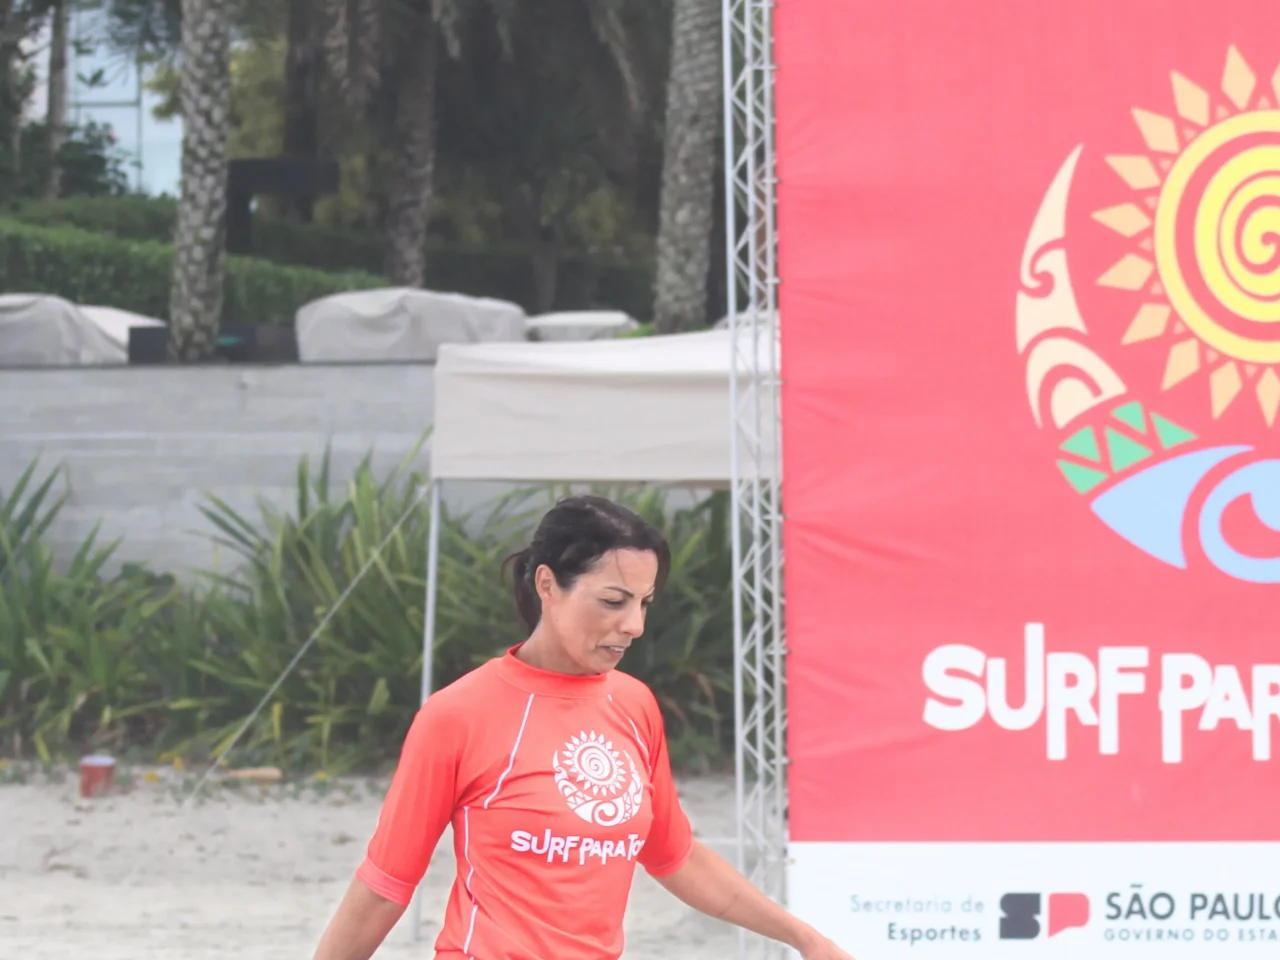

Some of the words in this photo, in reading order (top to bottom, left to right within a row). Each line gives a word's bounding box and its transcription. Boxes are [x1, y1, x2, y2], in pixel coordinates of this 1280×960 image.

[922, 622, 1149, 760] SURF
[511, 828, 580, 863] SURF
[579, 837, 627, 866] PARA
[850, 893, 952, 913] Secretaria
[961, 893, 984, 913] de
[1105, 883, 1176, 921] SÃO
[887, 921, 982, 946] Esportes
[1103, 927, 1195, 942] GOVERNO
[1203, 927, 1230, 942] DO
